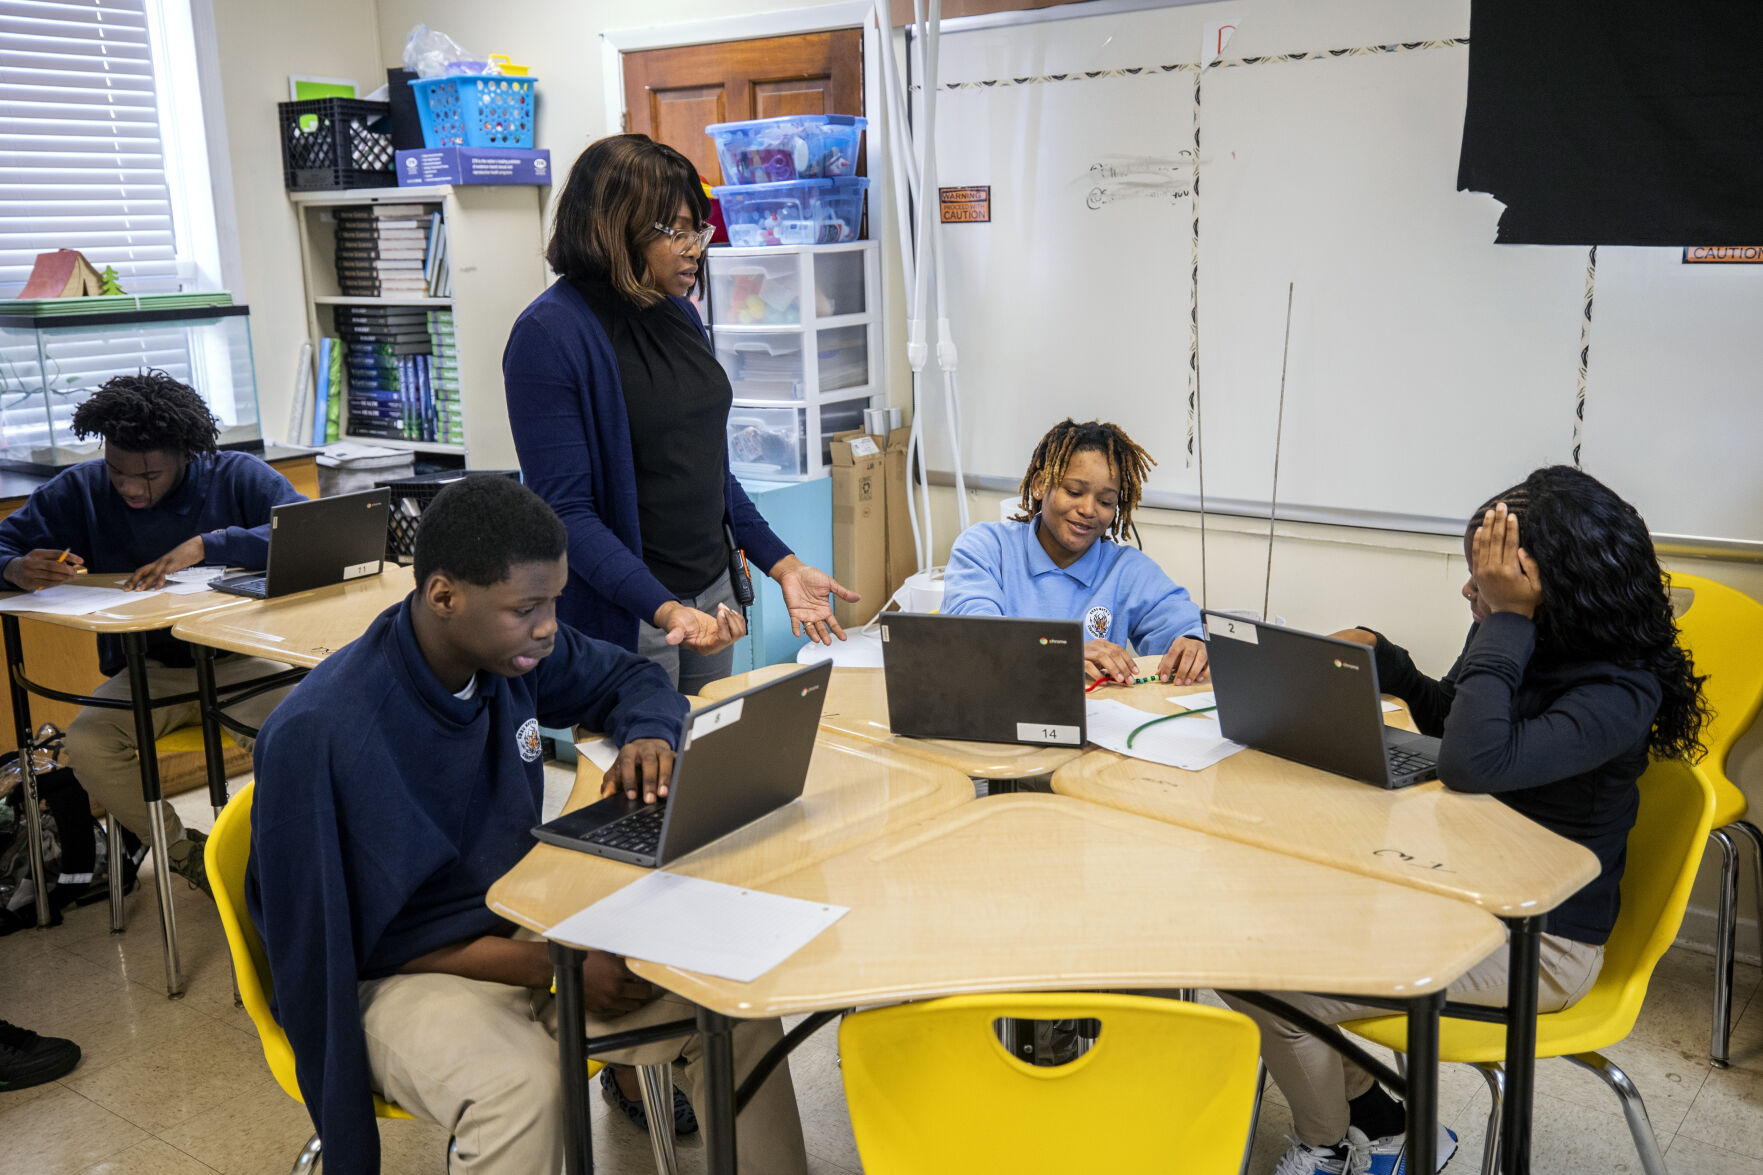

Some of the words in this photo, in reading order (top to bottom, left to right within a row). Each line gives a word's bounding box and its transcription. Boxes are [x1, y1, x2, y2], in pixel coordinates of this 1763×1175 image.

[943, 192, 982, 200] WARNING
[944, 210, 986, 220] CAUTION
[1228, 623, 1235, 634] 2
[1042, 728, 1057, 739] 14
